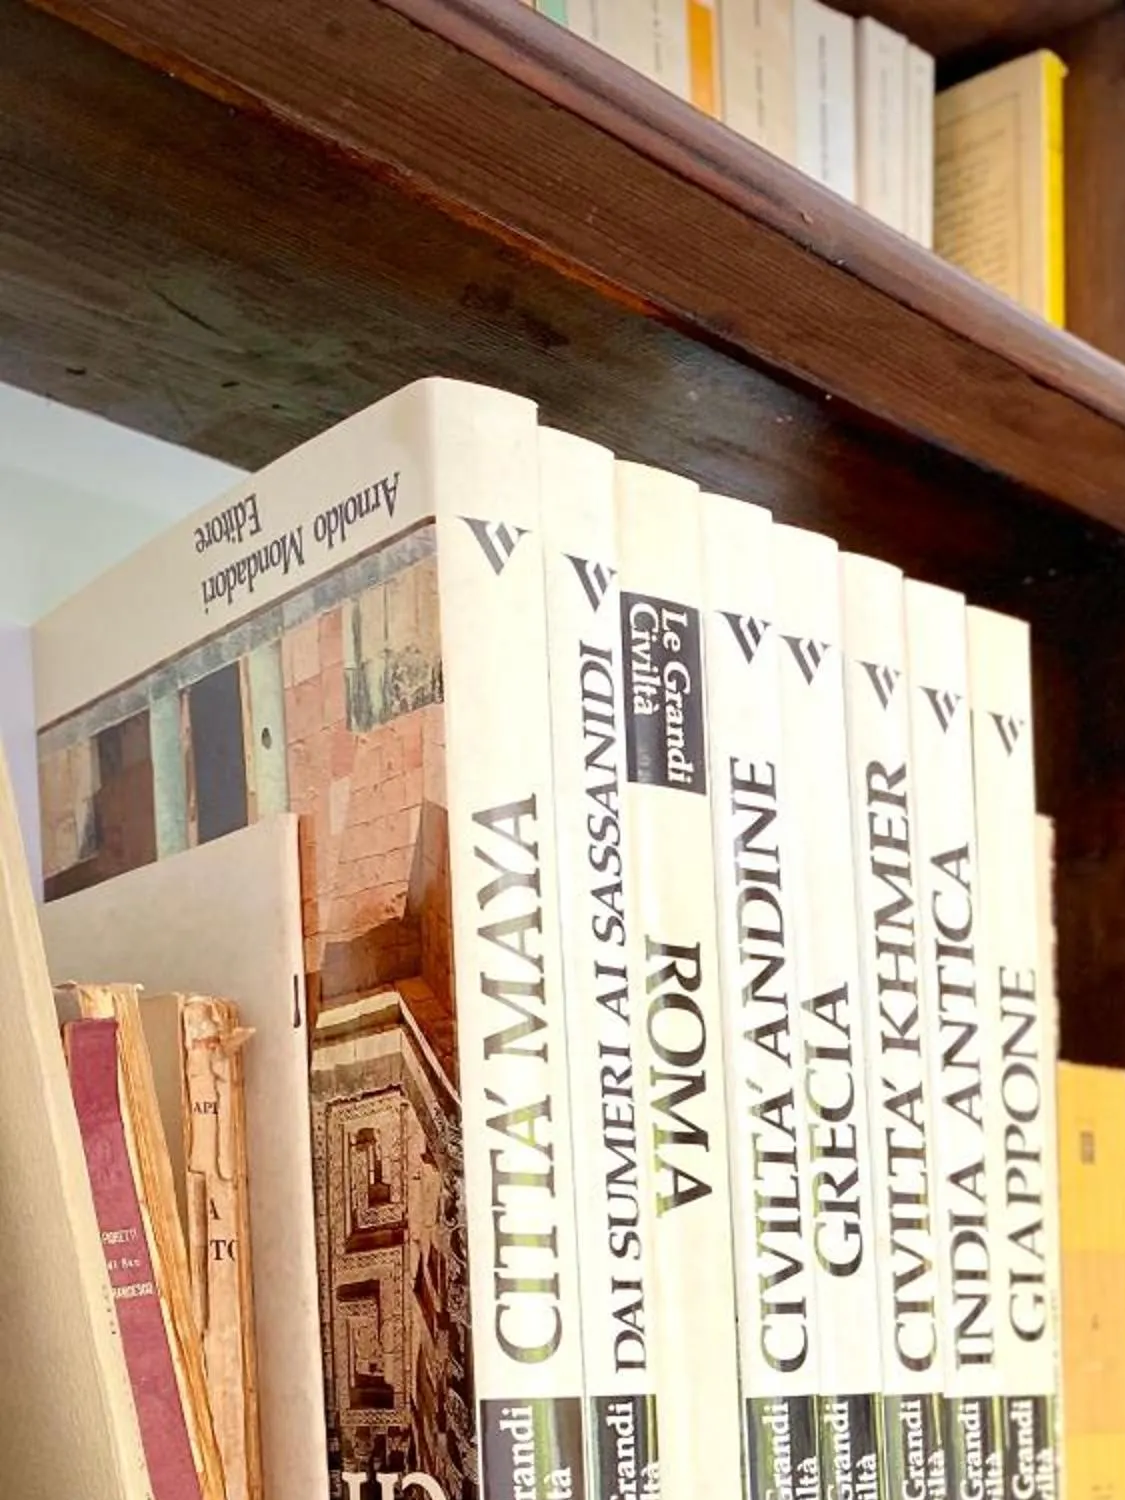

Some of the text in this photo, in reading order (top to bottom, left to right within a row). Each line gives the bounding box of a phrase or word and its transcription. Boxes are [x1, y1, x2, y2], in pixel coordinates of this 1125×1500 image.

[193, 493, 262, 553] Editore
[201, 471, 400, 614] Arnoldo Mondadori
[629, 603, 661, 716] Civiltà
[661, 607, 694, 785] Le Grandi
[471, 792, 549, 1064] MAYA
[579, 639, 647, 1374] DAI SUMERI AI SASSANIDI
[730, 756, 793, 1069] ANDINE
[866, 760, 922, 1058] KHMER
[644, 933, 713, 1218] ROMA
[800, 981, 863, 1278] GRECIA
[930, 842, 994, 1370] INDIA ANTICA
[999, 966, 1046, 1343] GIAPPONE
[1010, 1400, 1034, 1500] Grandi
